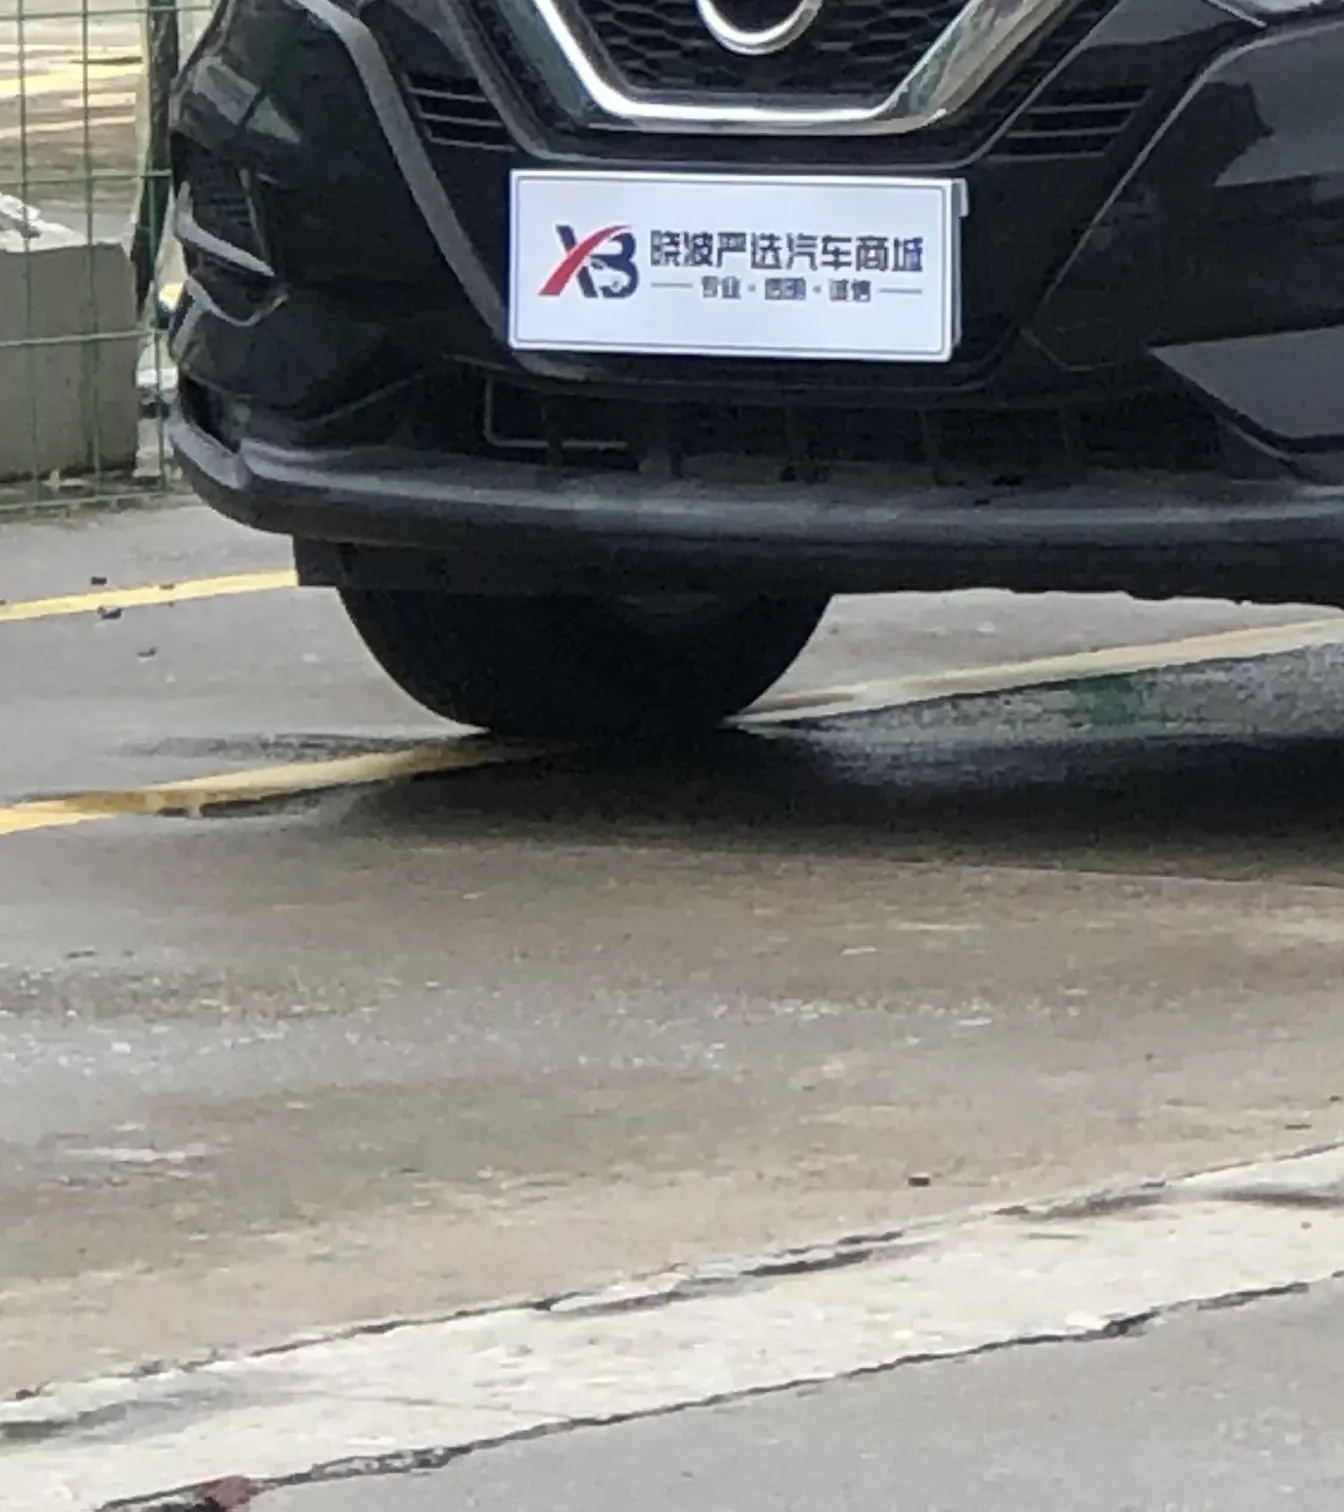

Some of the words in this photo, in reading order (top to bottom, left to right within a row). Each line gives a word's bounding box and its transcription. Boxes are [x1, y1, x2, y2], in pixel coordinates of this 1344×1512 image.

[650, 229, 924, 273] 晓波严选汽车商城
